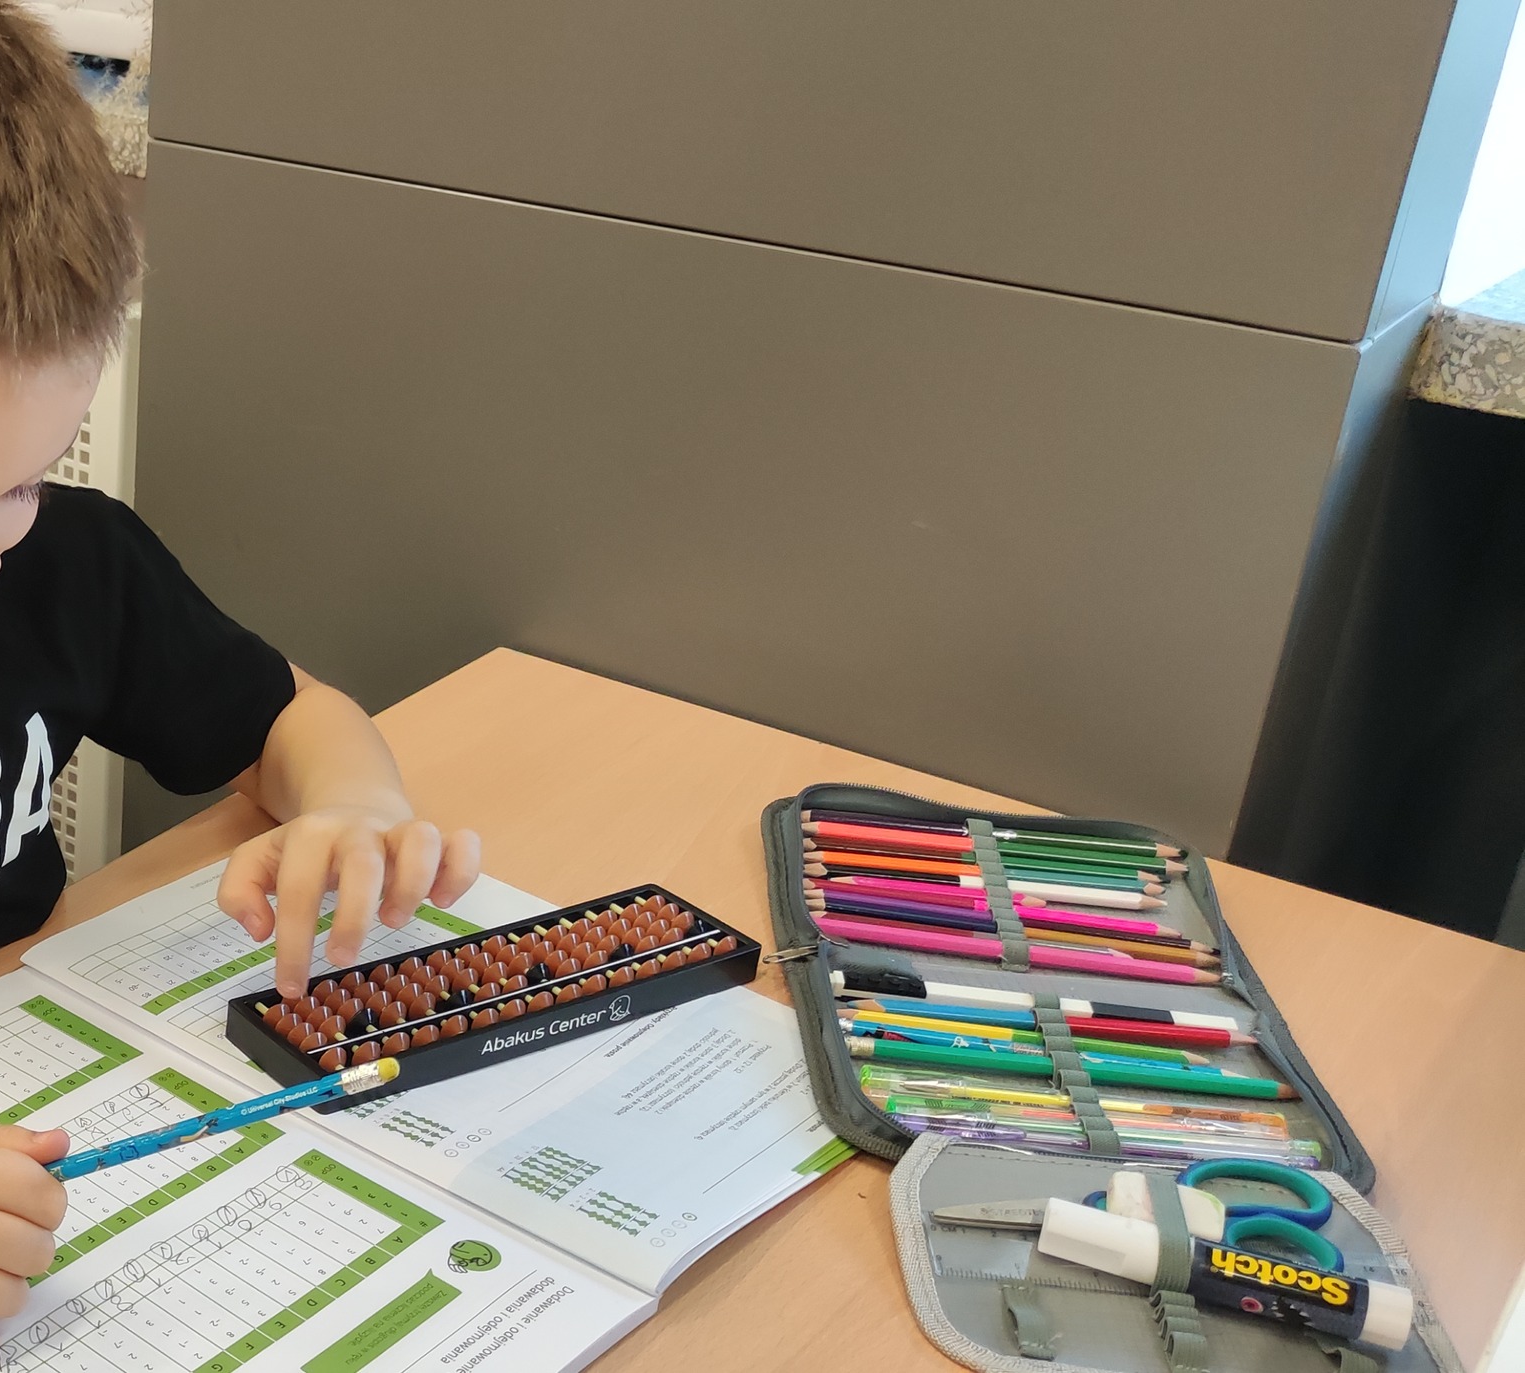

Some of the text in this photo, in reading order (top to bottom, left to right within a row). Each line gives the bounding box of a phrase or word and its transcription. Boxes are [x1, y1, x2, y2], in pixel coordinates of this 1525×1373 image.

[480, 1008, 607, 1056] Abakus Center
[247, 1101, 274, 1114] Universal
[284, 1090, 308, 1102] Studios
[1211, 1247, 1351, 1306] Scotch
[306, 1298, 318, 1306] D
[505, 1277, 554, 1313] dodawania
[521, 1286, 574, 1323] Dodawanie
[245, 1342, 254, 1350] F
[440, 1316, 503, 1363] odejmowania
[456, 1327, 519, 1373] odejmowanie
[211, 1364, 223, 1373] G
